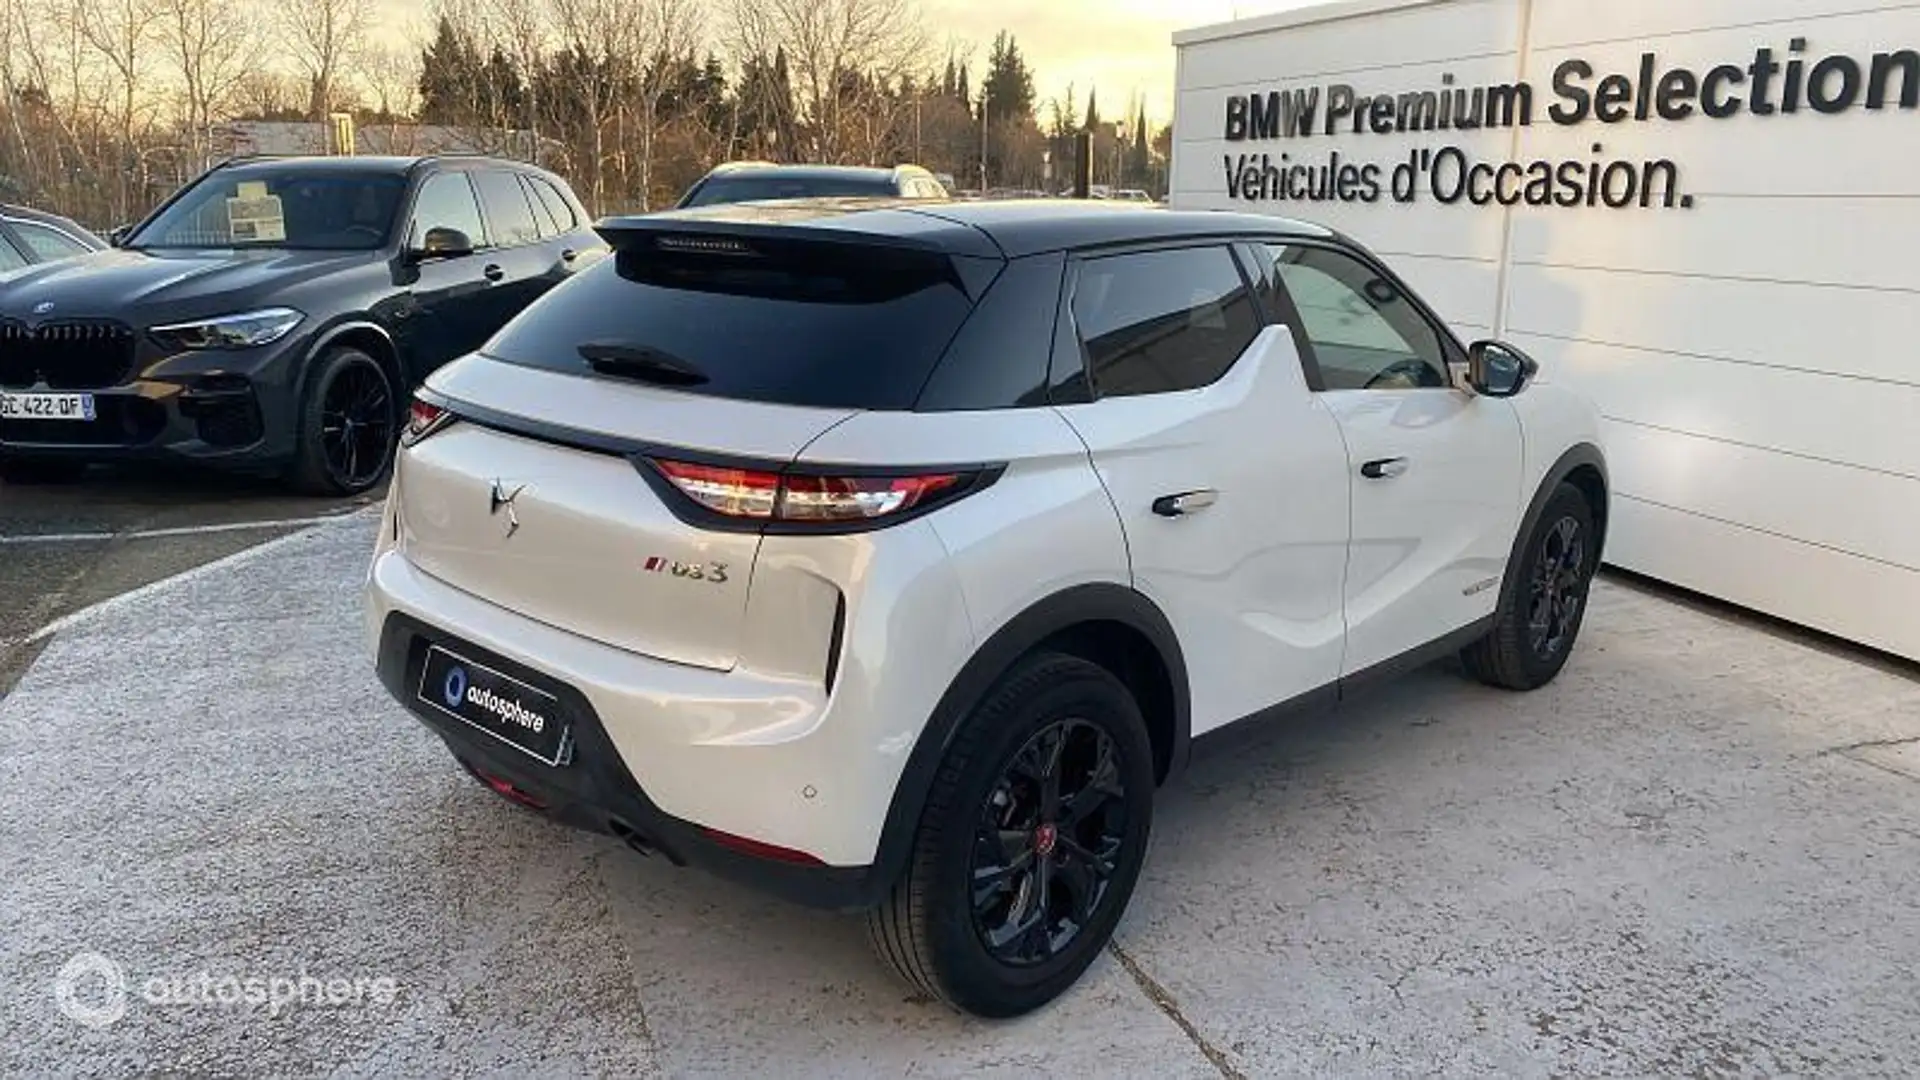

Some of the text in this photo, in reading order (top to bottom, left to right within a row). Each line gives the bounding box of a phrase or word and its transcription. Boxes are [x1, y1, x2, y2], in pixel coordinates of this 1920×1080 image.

[1225, 37, 1920, 140] BMW Premium Selection
[1224, 143, 1694, 208] Véhicules d'Occasion.
[467, 685, 544, 733] autosphere
